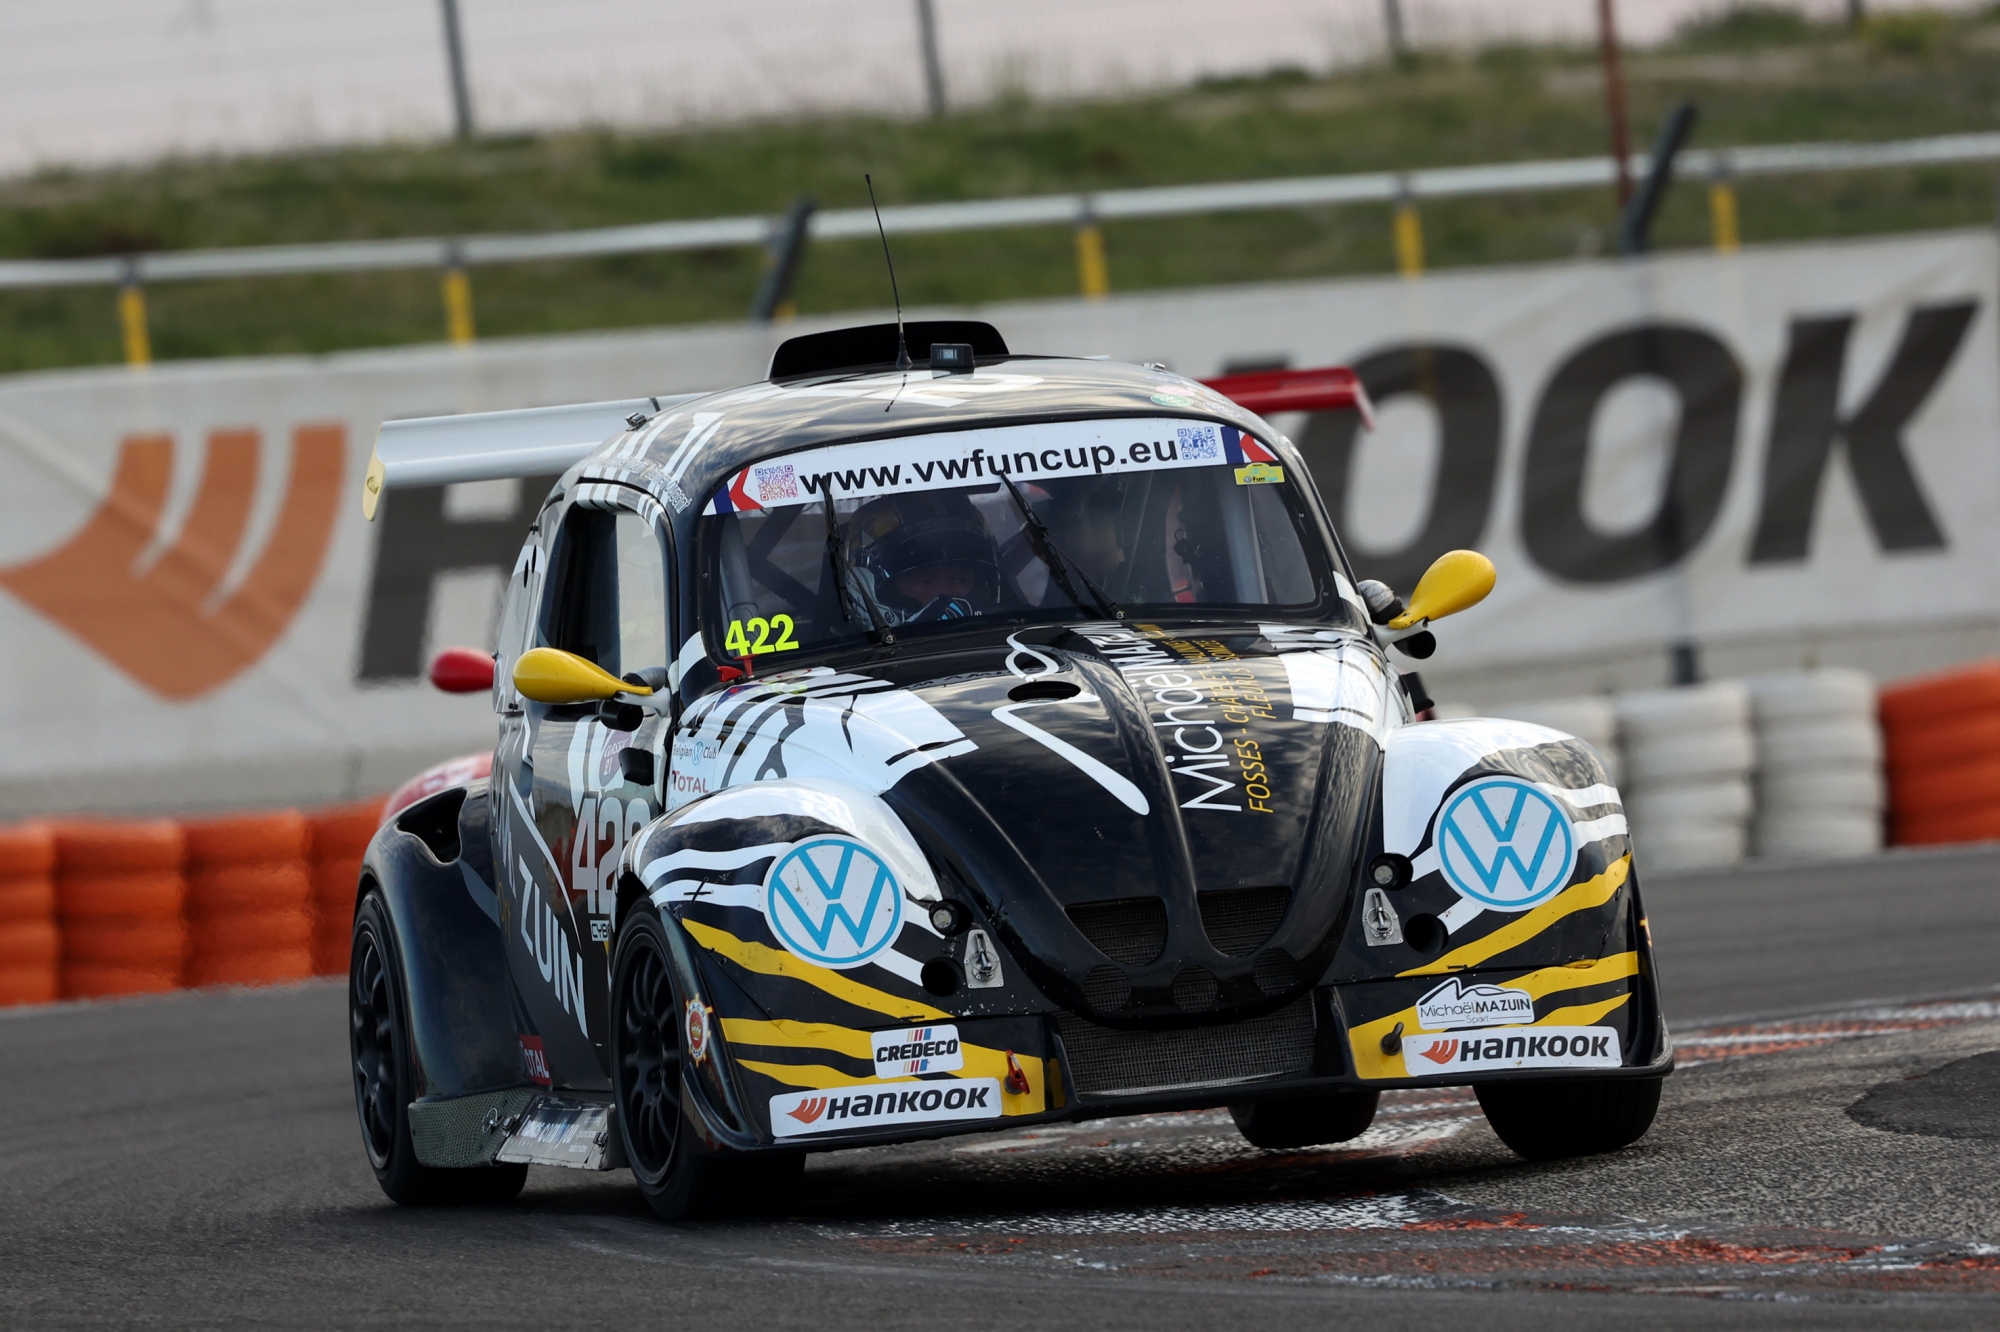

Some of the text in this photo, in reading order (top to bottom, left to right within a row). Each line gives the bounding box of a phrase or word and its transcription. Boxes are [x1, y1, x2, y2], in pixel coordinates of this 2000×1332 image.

[800, 438, 1178, 496] www.vwfuncup.eu
[724, 613, 801, 658] 422
[1225, 667, 1277, 719] FLEURUS
[672, 743, 693, 761] Belgian
[702, 746, 718, 761] Club
[672, 770, 709, 794] TOTAL
[1233, 738, 1274, 813] FOSSES
[1420, 998, 1531, 1018] Michaël MAZUIN
[1466, 1014, 1489, 1024] Sport
[519, 1040, 550, 1078] OTAL
[876, 1038, 959, 1063] CREDECO
